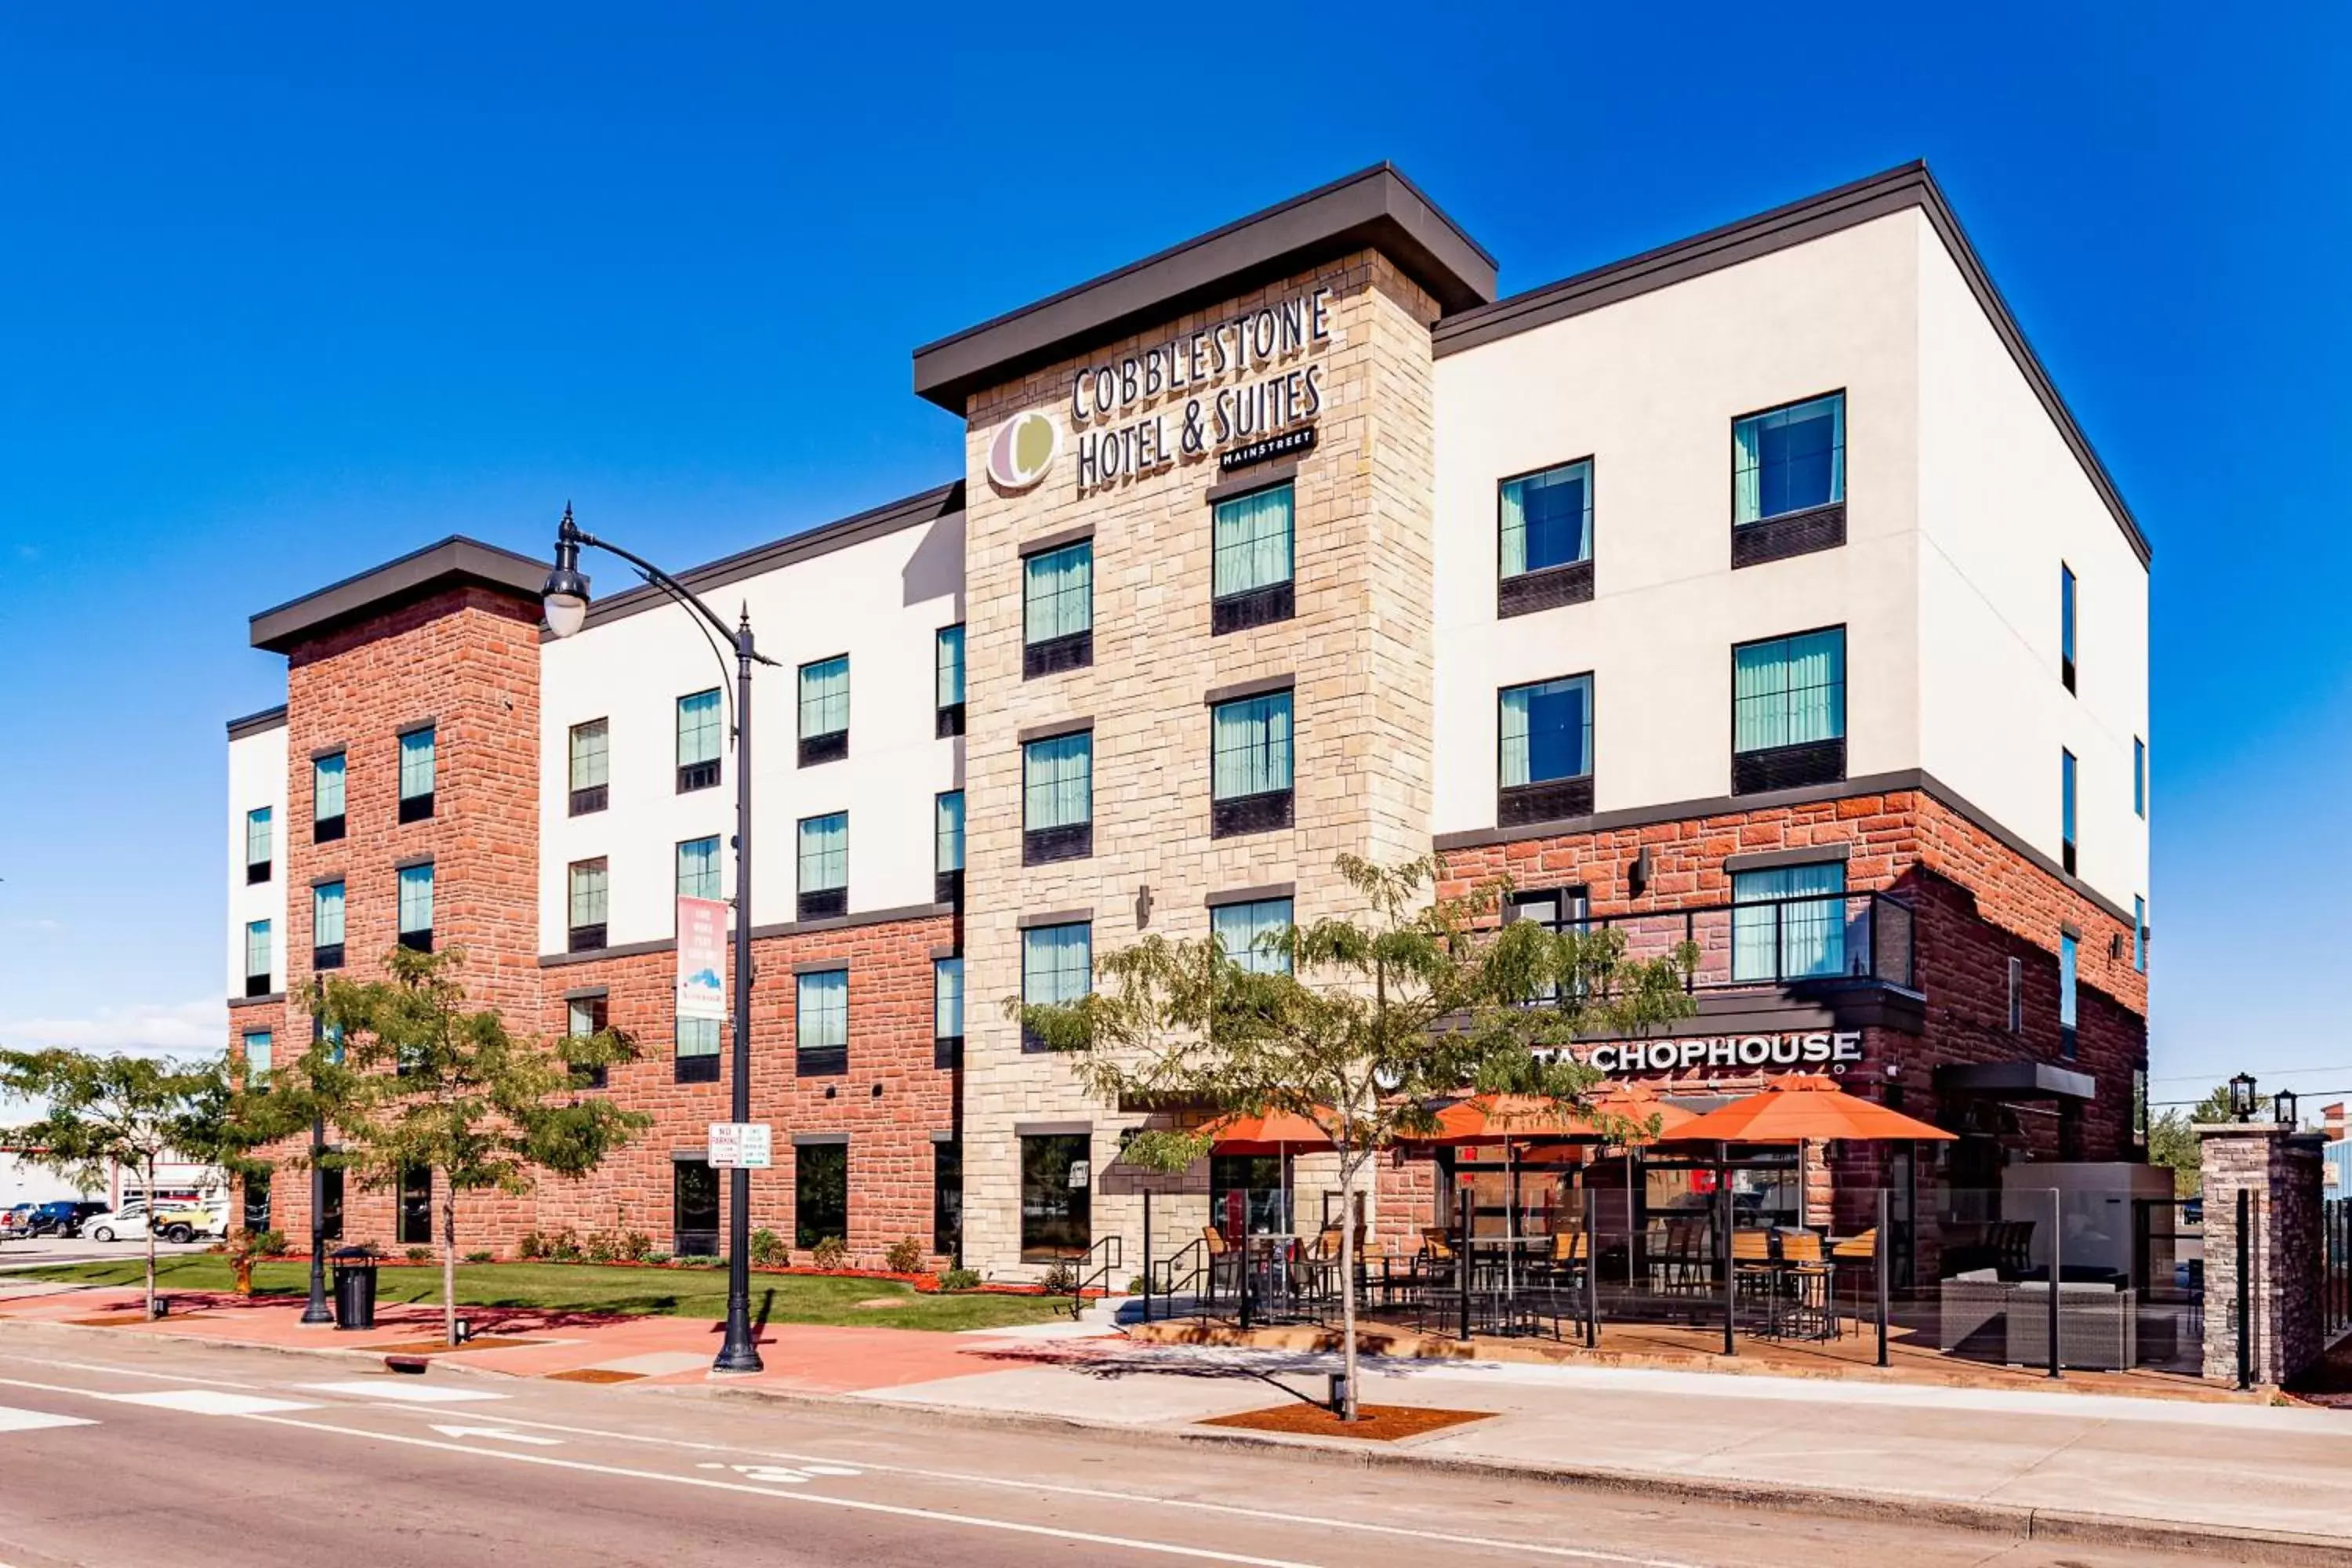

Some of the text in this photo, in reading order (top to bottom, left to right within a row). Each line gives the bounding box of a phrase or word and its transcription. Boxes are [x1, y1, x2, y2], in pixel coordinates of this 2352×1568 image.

[1072, 286, 1333, 422] COBBLESTONE
[1079, 364, 1322, 488] HOTEL & SUITES
[1223, 431, 1312, 466] MAINSTREET
[1590, 1030, 1862, 1073] CHOPHOUSE
[719, 1127, 731, 1136] NO
